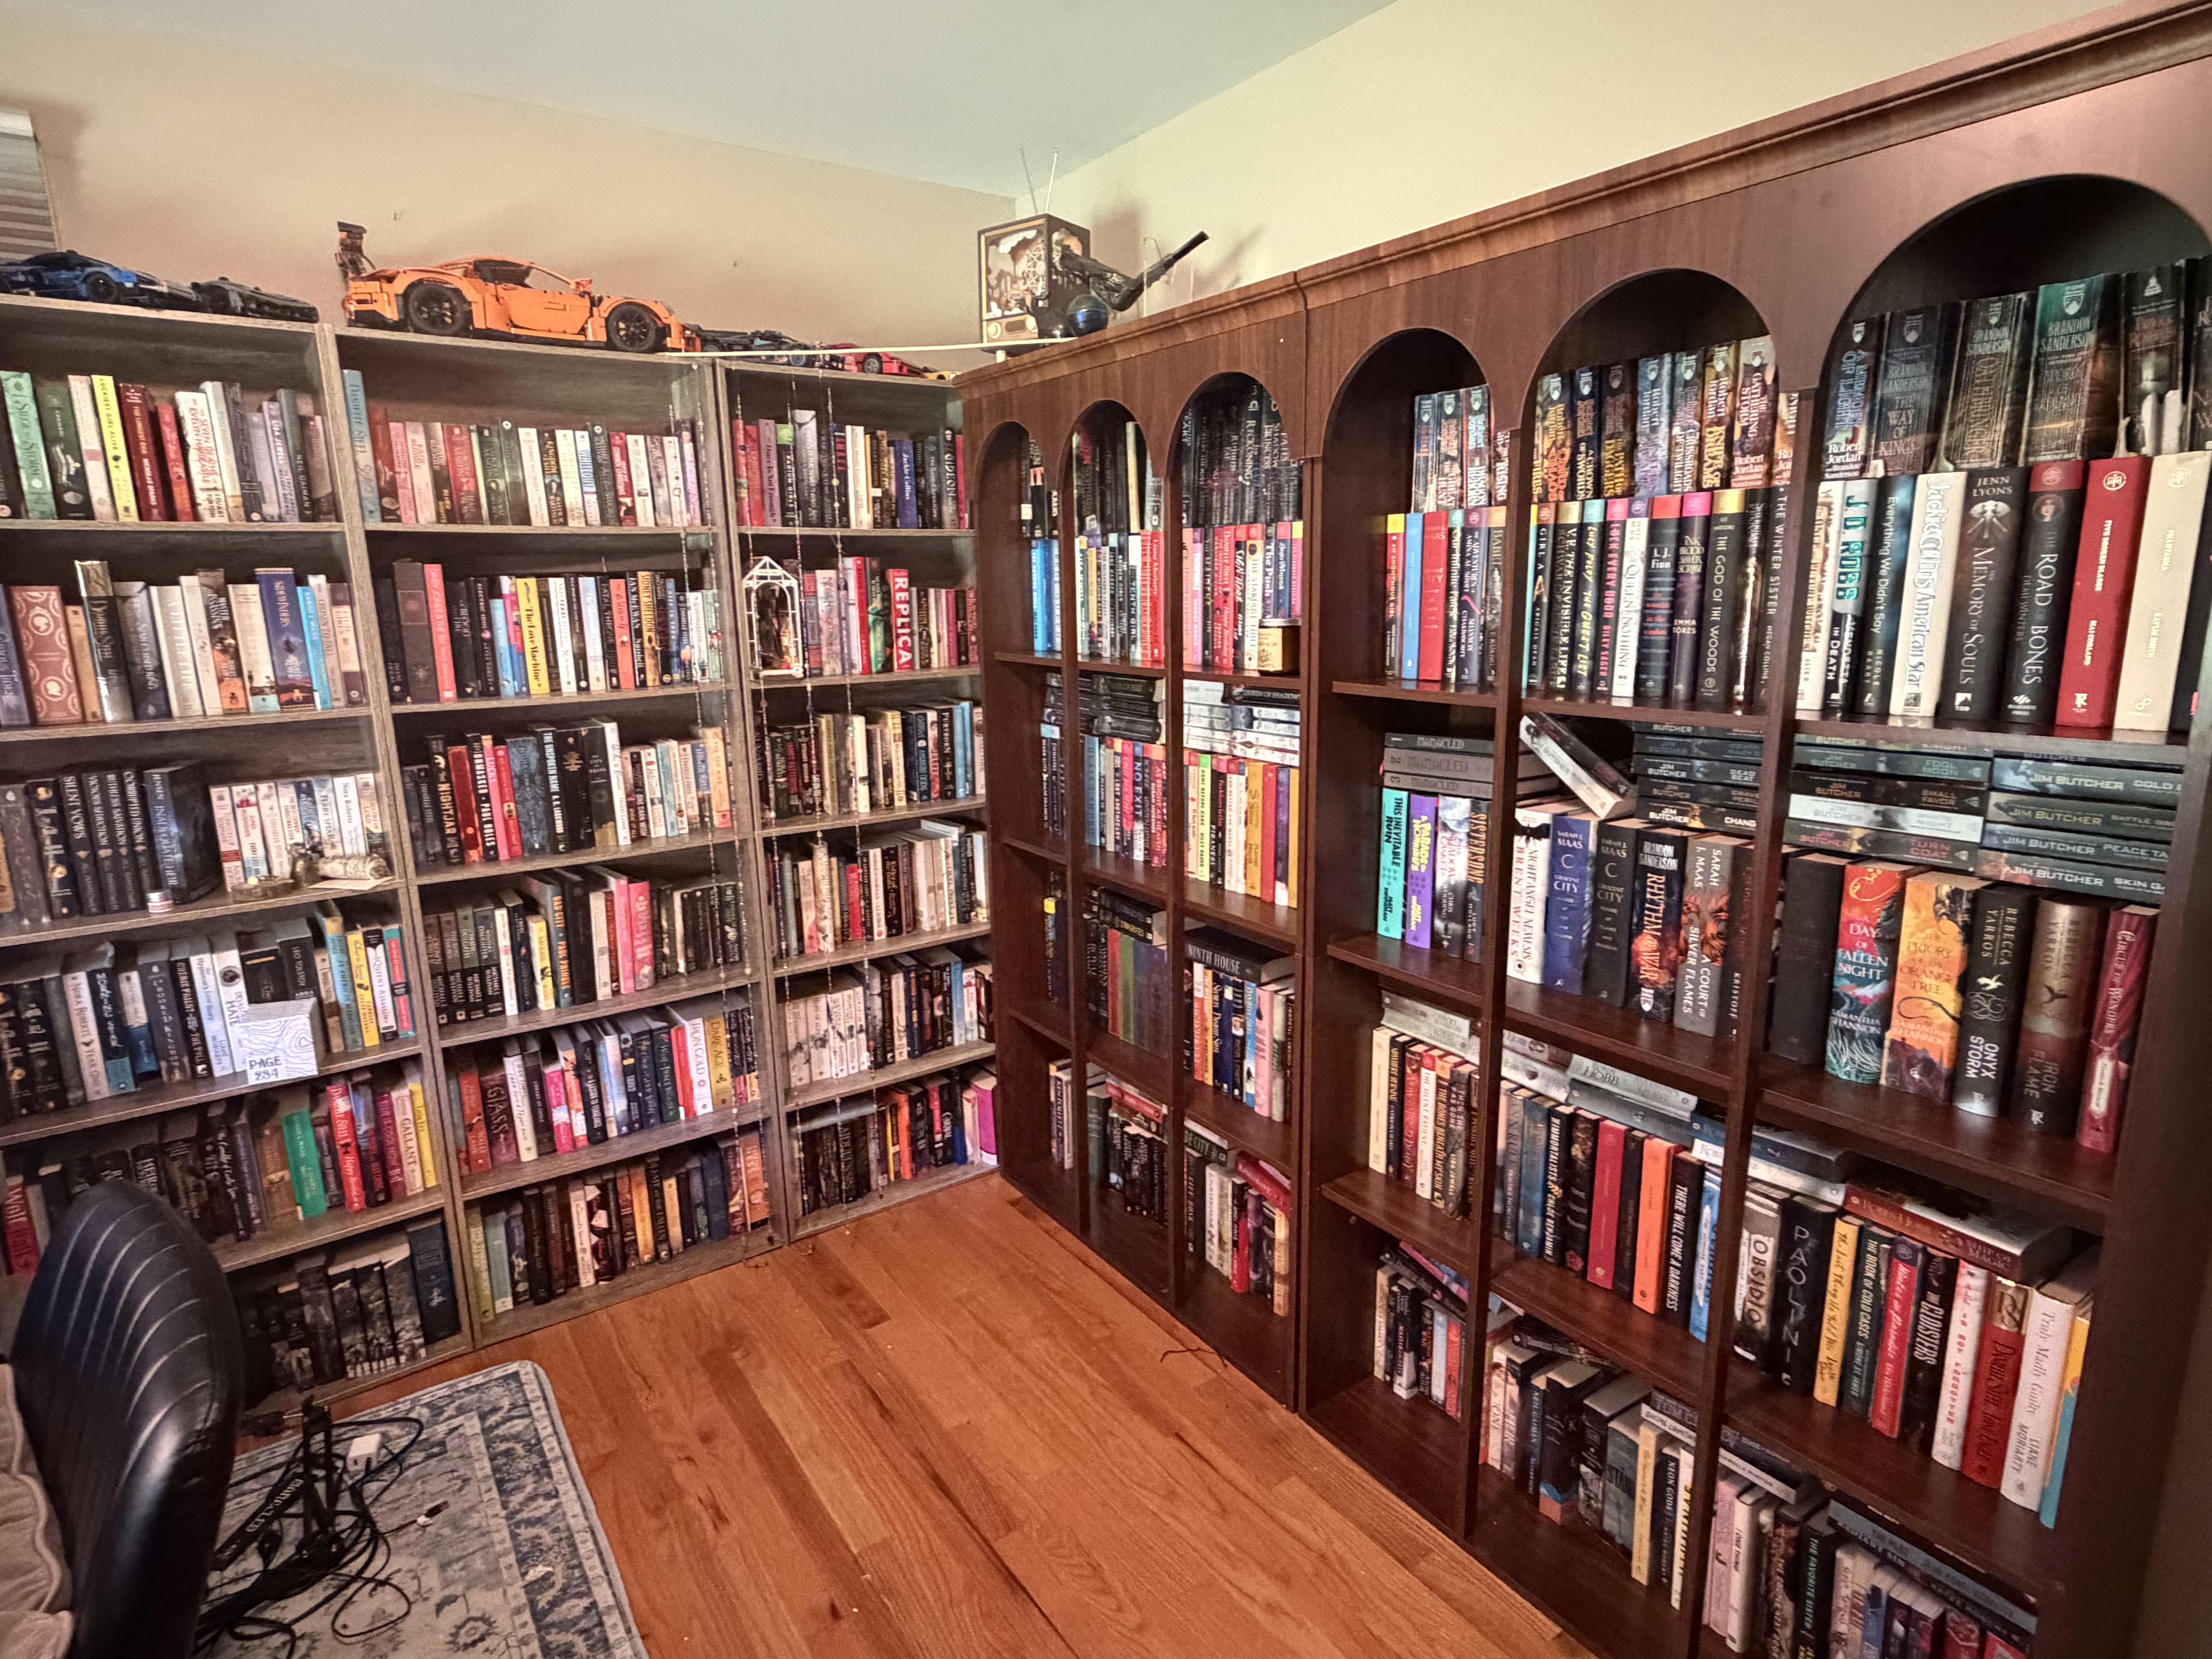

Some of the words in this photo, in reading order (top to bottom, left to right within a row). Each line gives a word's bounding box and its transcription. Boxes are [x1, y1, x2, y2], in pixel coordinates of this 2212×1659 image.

[1972, 485, 2013, 497] LYONS
[1977, 476, 2010, 487] JENN
[1774, 495, 1788, 519] THE
[1877, 496, 1897, 556] Everything
[1537, 527, 1547, 557] GIRL
[1716, 536, 1728, 551] THE
[1771, 522, 1785, 570] WINTER
[1713, 555, 1726, 585] GOD
[1879, 557, 1891, 577] We
[1766, 576, 1780, 615] SISTER
[894, 577, 913, 670] REPLICA
[1710, 606, 1722, 621] THE
[1870, 613, 1885, 634] Say
[1706, 625, 1719, 673] WOODS
[1826, 639, 1840, 680] DEATH
[1577, 651, 1590, 677] LIST
[473, 754, 488, 793] UNMASKED
[1134, 762, 1142, 782] NO
[1647, 768, 1686, 778] BUTCHER
[2029, 774, 2052, 783] JIM
[2055, 775, 2124, 790] BUTCHER
[1921, 790, 1957, 799] SMALL
[2133, 780, 2173, 790] COLD
[437, 782, 457, 834] NIGHTJAR
[480, 803, 492, 821] PAUL
[1134, 787, 1142, 817] EXIT
[1394, 797, 1403, 816] THIS
[1922, 797, 1956, 806] FAVOR
[70, 809, 86, 839] VOWS
[1384, 816, 1393, 843] RUIN
[1649, 812, 1689, 824] BUTCHER
[2035, 811, 2102, 826] BUTCHER
[483, 823, 496, 847] HOLES
[1391, 816, 1403, 867] INEVITABLE
[1558, 837, 1583, 849] MAAS
[2003, 836, 2025, 845] JIM
[2029, 839, 2095, 854] BUTCHER
[1467, 812, 1487, 884] SISTERSONG
[1643, 842, 1674, 857] BRANDON
[2103, 844, 2150, 856] PEACE
[1638, 853, 1678, 871] SANDERSON
[1709, 848, 1722, 887] SARAH
[1553, 880, 1578, 893] CITY
[2011, 866, 2033, 875] JIM
[2036, 869, 2104, 886] BUTCHER
[2114, 878, 2147, 888] SKIN
[1642, 873, 1666, 936] RHYTHM
[1849, 923, 1880, 938] DAY
[1981, 909, 1998, 958] YARROS
[1999, 907, 2018, 966] REBECCA
[1686, 926, 1700, 966] SILVER
[1855, 941, 1868, 950] OF
[1188, 944, 1213, 964] NINTH
[1214, 953, 1241, 974] HOUSE
[1639, 951, 1660, 980] WAR
[1837, 948, 1888, 967] FALLEN
[1838, 963, 1885, 981] NIGHT
[1682, 968, 1695, 1015] FLAMES
[711, 1020, 721, 1045] DARK
[1829, 1018, 1881, 1034] SHANNON
[249, 1057, 282, 1070] PAGE
[694, 1047, 705, 1076] GOLD
[1965, 1036, 1984, 1079] STORM
[1980, 1042, 1999, 1079] ONYX
[1584, 1066, 1620, 1085] HOBB
[402, 1118, 417, 1165] GALLANT
[1674, 1185, 1688, 1214] THERE
[1672, 1213, 1685, 1235] WILL
[1670, 1235, 1683, 1261] COME
[1669, 1259, 1681, 1267] A
[1666, 1267, 1681, 1312] DARKNESS
[1858, 1316, 1871, 1339] CASES
